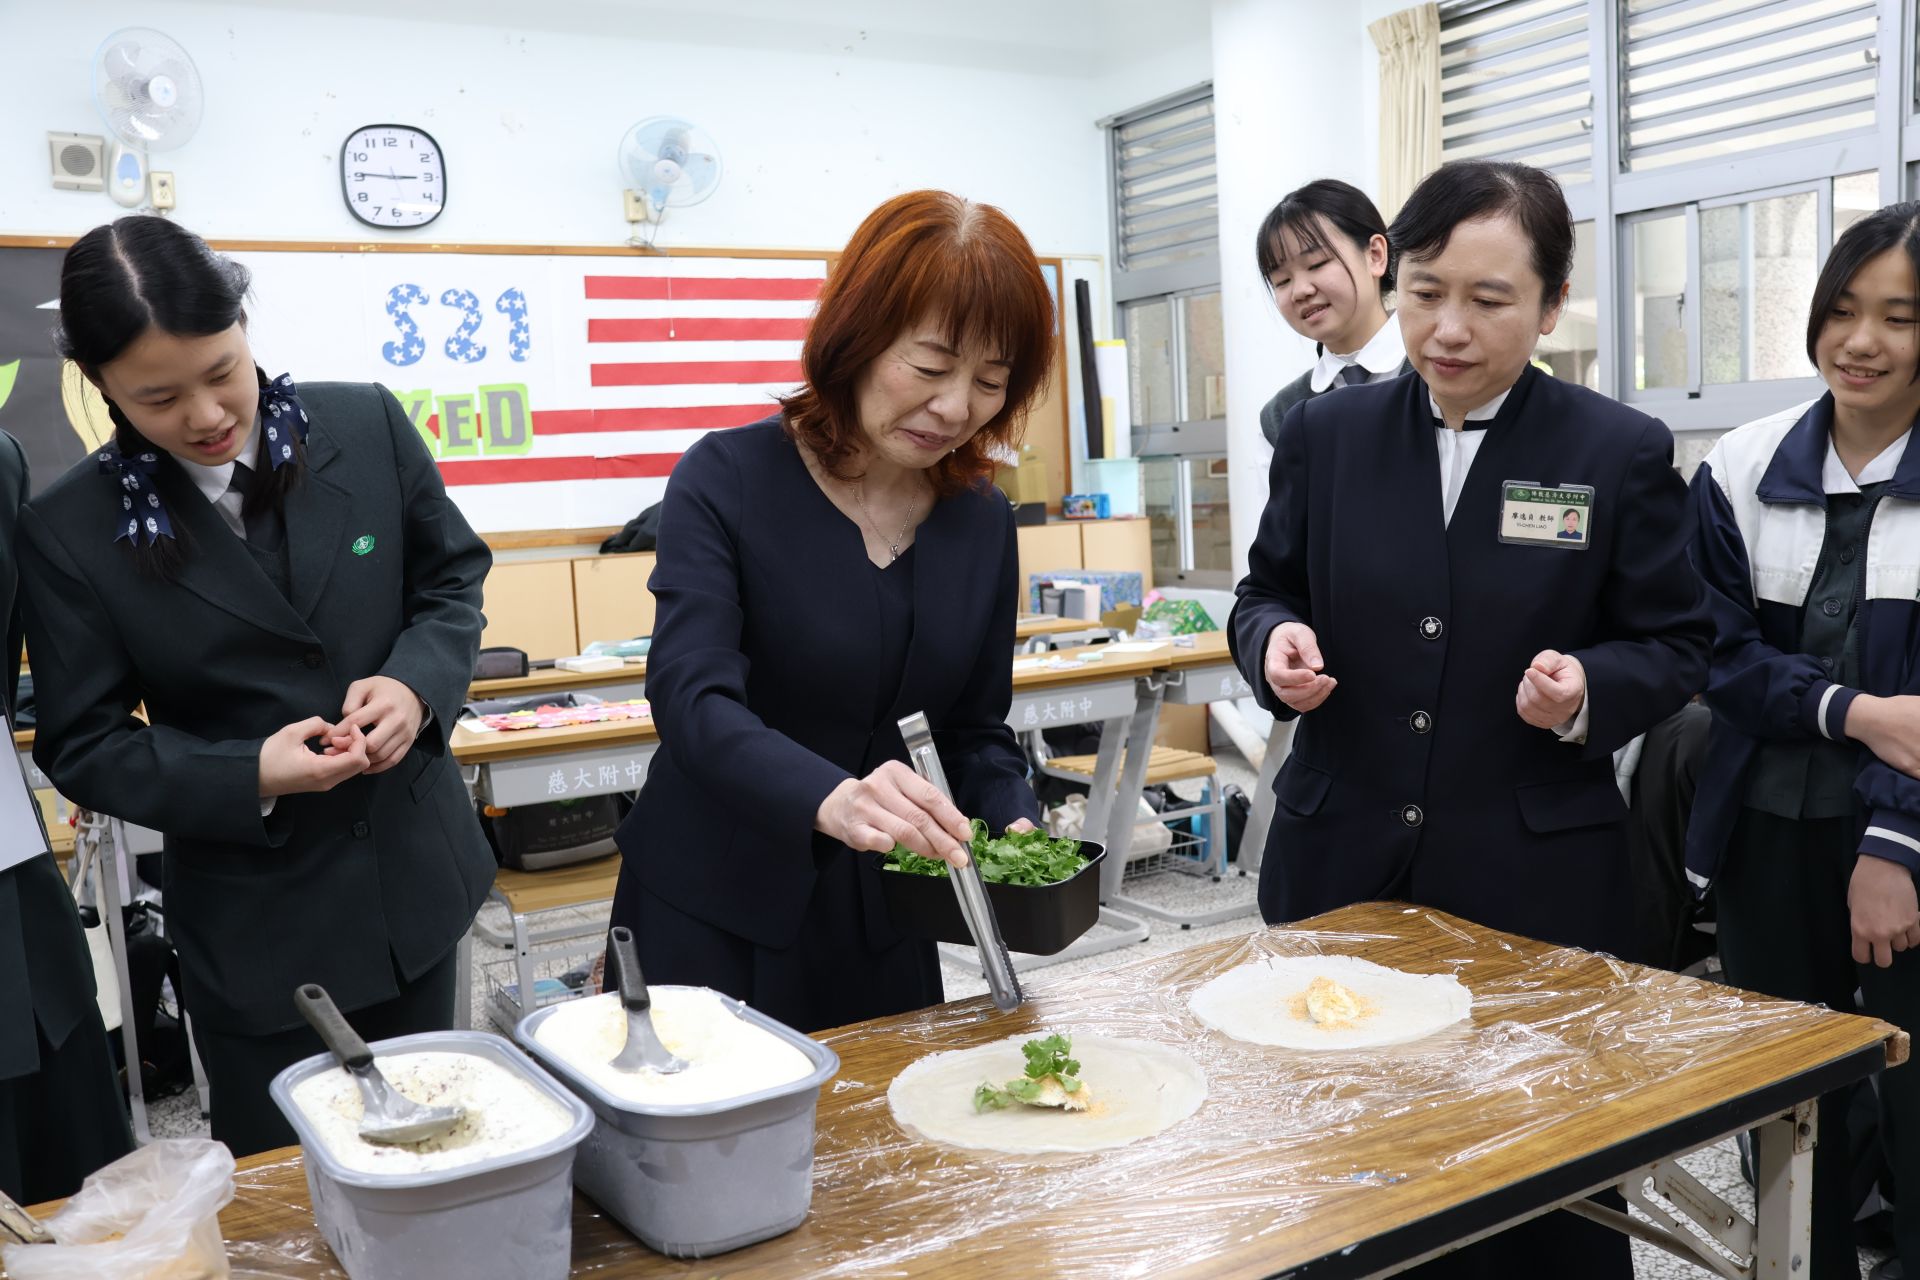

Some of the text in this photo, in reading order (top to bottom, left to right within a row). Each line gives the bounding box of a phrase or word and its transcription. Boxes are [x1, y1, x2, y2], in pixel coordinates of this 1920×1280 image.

[365, 138, 375, 148] 11
[383, 137, 398, 147] 12
[353, 152, 368, 162] 10
[420, 153, 430, 162] 2
[354, 172, 365, 181] 9
[424, 173, 433, 182] 3
[357, 192, 368, 202] 8
[423, 193, 432, 201] 4
[373, 206, 382, 216] 7
[392, 208, 402, 217] 6
[403, 389, 526, 448] ED
[1024, 697, 1092, 725] 慈大附中
[548, 760, 642, 794] 慈大附中
